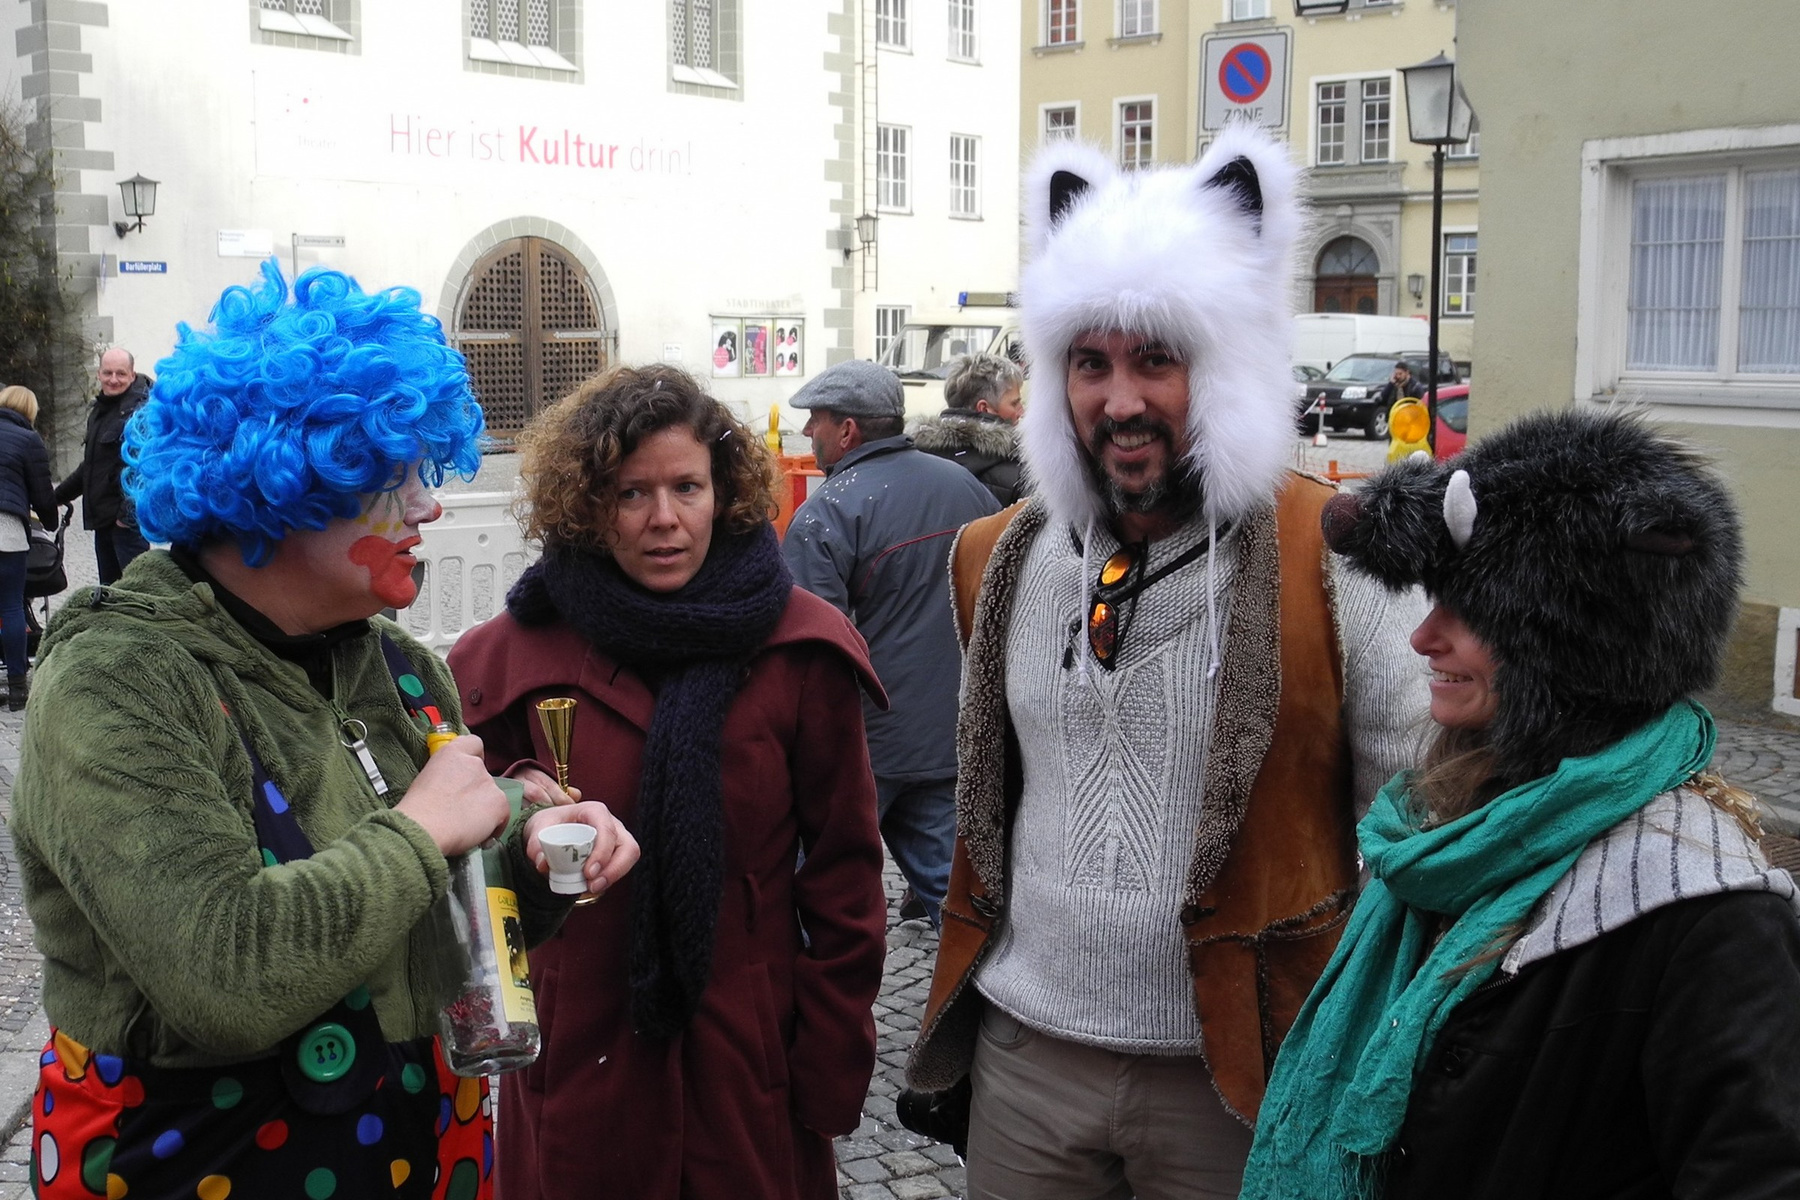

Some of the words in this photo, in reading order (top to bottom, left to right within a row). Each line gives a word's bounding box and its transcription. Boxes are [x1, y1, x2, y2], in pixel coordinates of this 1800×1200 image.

[1223, 107, 1263, 124] ZONE
[391, 113, 455, 157] Hier
[470, 120, 505, 162] ist
[519, 125, 619, 169] Kultur
[630, 137, 691, 175] drin!
